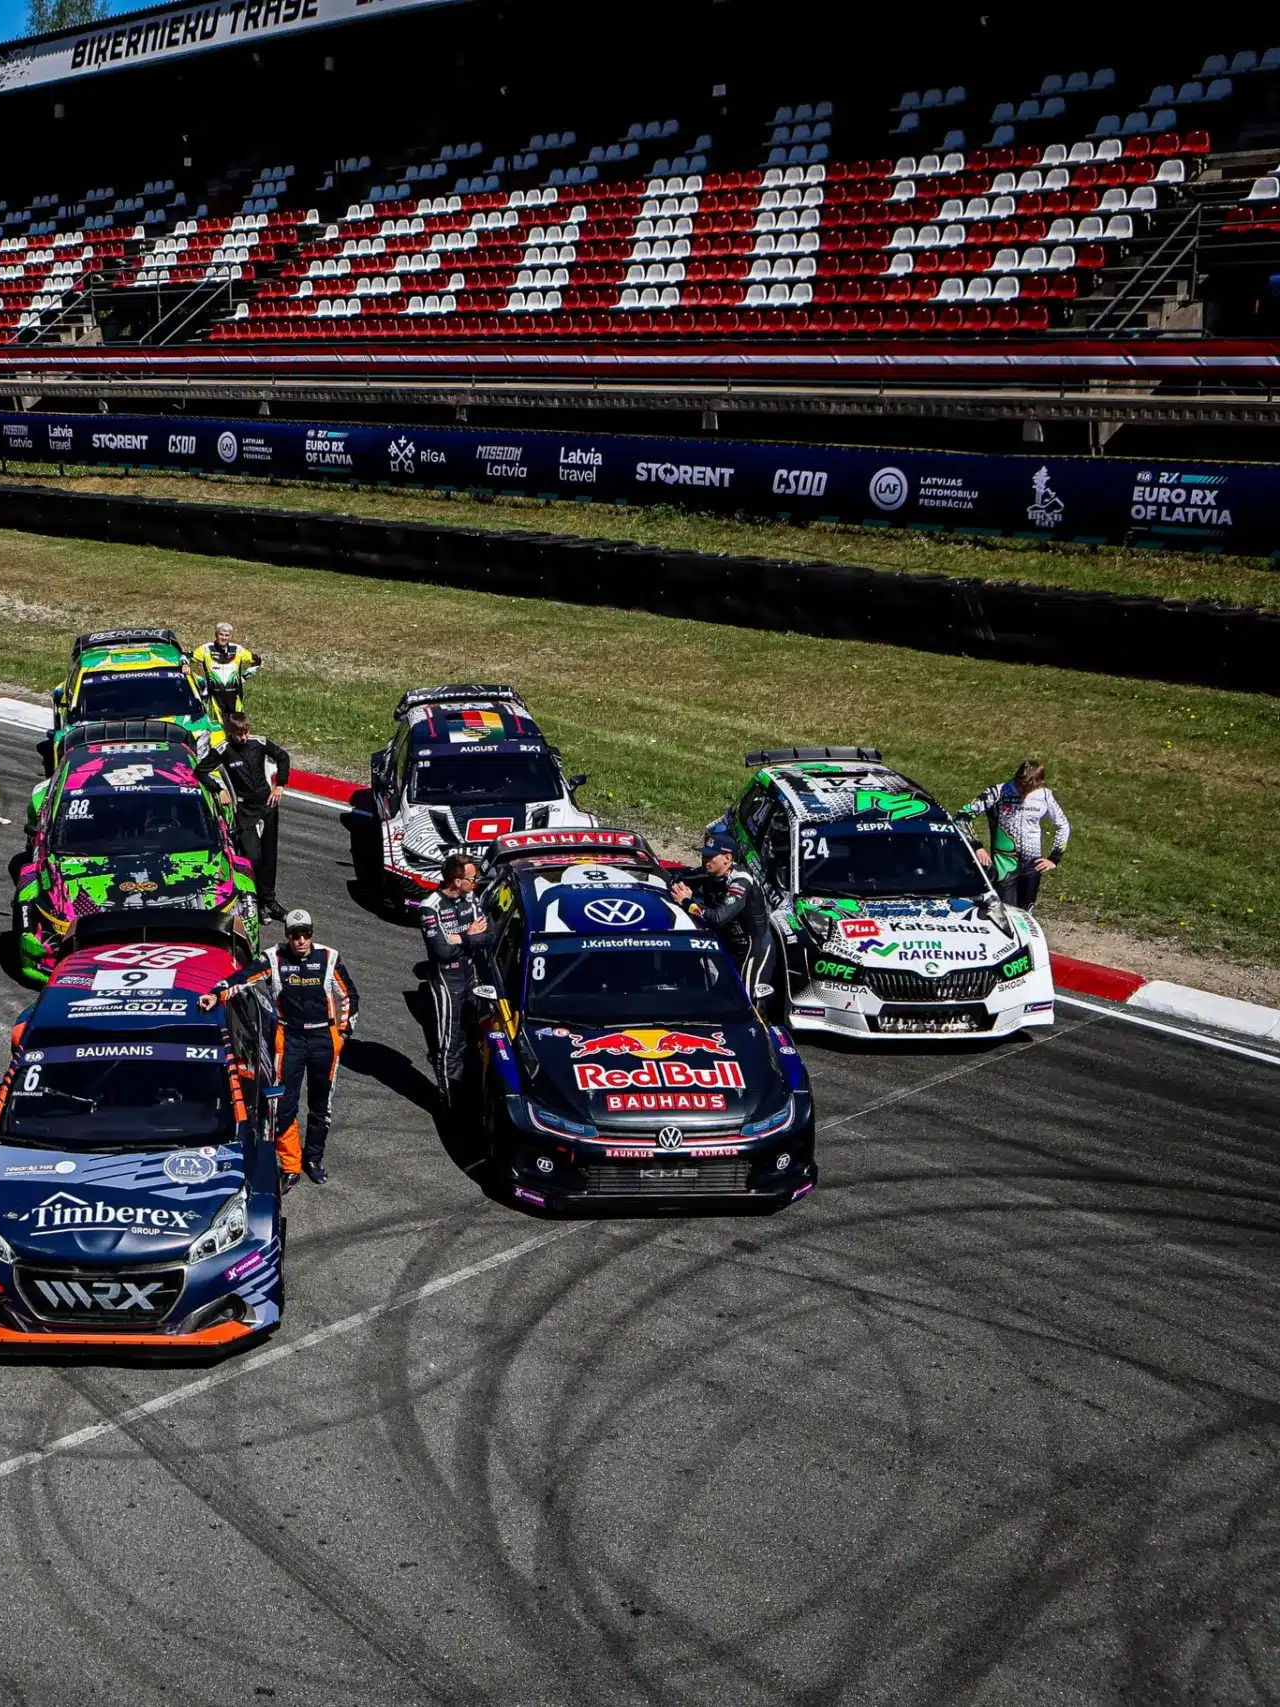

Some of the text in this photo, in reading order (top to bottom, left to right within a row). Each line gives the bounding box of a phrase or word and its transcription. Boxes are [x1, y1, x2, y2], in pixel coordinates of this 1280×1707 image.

[48, 424, 73, 438] Latvia
[9, 437, 33, 448] Latvia
[48, 438, 72, 450] travel
[92, 433, 149, 450] STORENT
[168, 434, 197, 454] CSDD
[305, 440, 345, 452] EURO RX
[305, 453, 353, 465] OF LATVIA
[420, 450, 447, 463] RĪGA
[476, 445, 522, 461] MISSION
[559, 446, 602, 466] Latvia
[486, 461, 527, 478] Latvia
[558, 466, 597, 483] travel
[635, 461, 734, 488] STORENT
[772, 468, 828, 497] CSDD
[919, 476, 963, 487] LATVIJAS
[1158, 472, 1180, 484] RX
[878, 483, 899, 495] LAF
[1132, 486, 1218, 506] EURO RX
[1131, 504, 1233, 525] OF LATVIA
[114, 629, 165, 637] RACING
[460, 745, 499, 753] AUGUST
[417, 760, 431, 768] 38
[113, 784, 202, 795] TREPÁK RX1
[68, 799, 90, 815] 88
[856, 820, 956, 833] SEPPÄ RX1
[505, 834, 634, 848] BAUHAUS
[801, 837, 830, 860] 24
[583, 870, 609, 881] 8
[844, 921, 992, 935] Plus Katsastus
[581, 939, 671, 949] J.Kristoffersson
[690, 939, 720, 950] RX1
[903, 940, 942, 950] UTIN
[898, 950, 988, 962] RAKENNUS
[531, 956, 546, 981] 8
[814, 960, 856, 980] ORPE
[1002, 955, 1031, 978] ORPE
[70, 1001, 189, 1013] PREMIUM GOLD
[76, 1045, 154, 1058] BAUMANIS
[185, 1047, 218, 1060] RX1
[23, 1063, 43, 1092] 6
[573, 1061, 746, 1090] Red Bull
[608, 1094, 726, 1111] BAUHAUS
[607, 1149, 654, 1157] BAUHAUS
[692, 1148, 739, 1156] BAUHAUS
[176, 1157, 204, 1169] TX
[175, 1167, 204, 1177] koks
[639, 1168, 699, 1178] KMS
[31, 1201, 190, 1229] Timberex
[131, 1226, 161, 1236] GROUP
